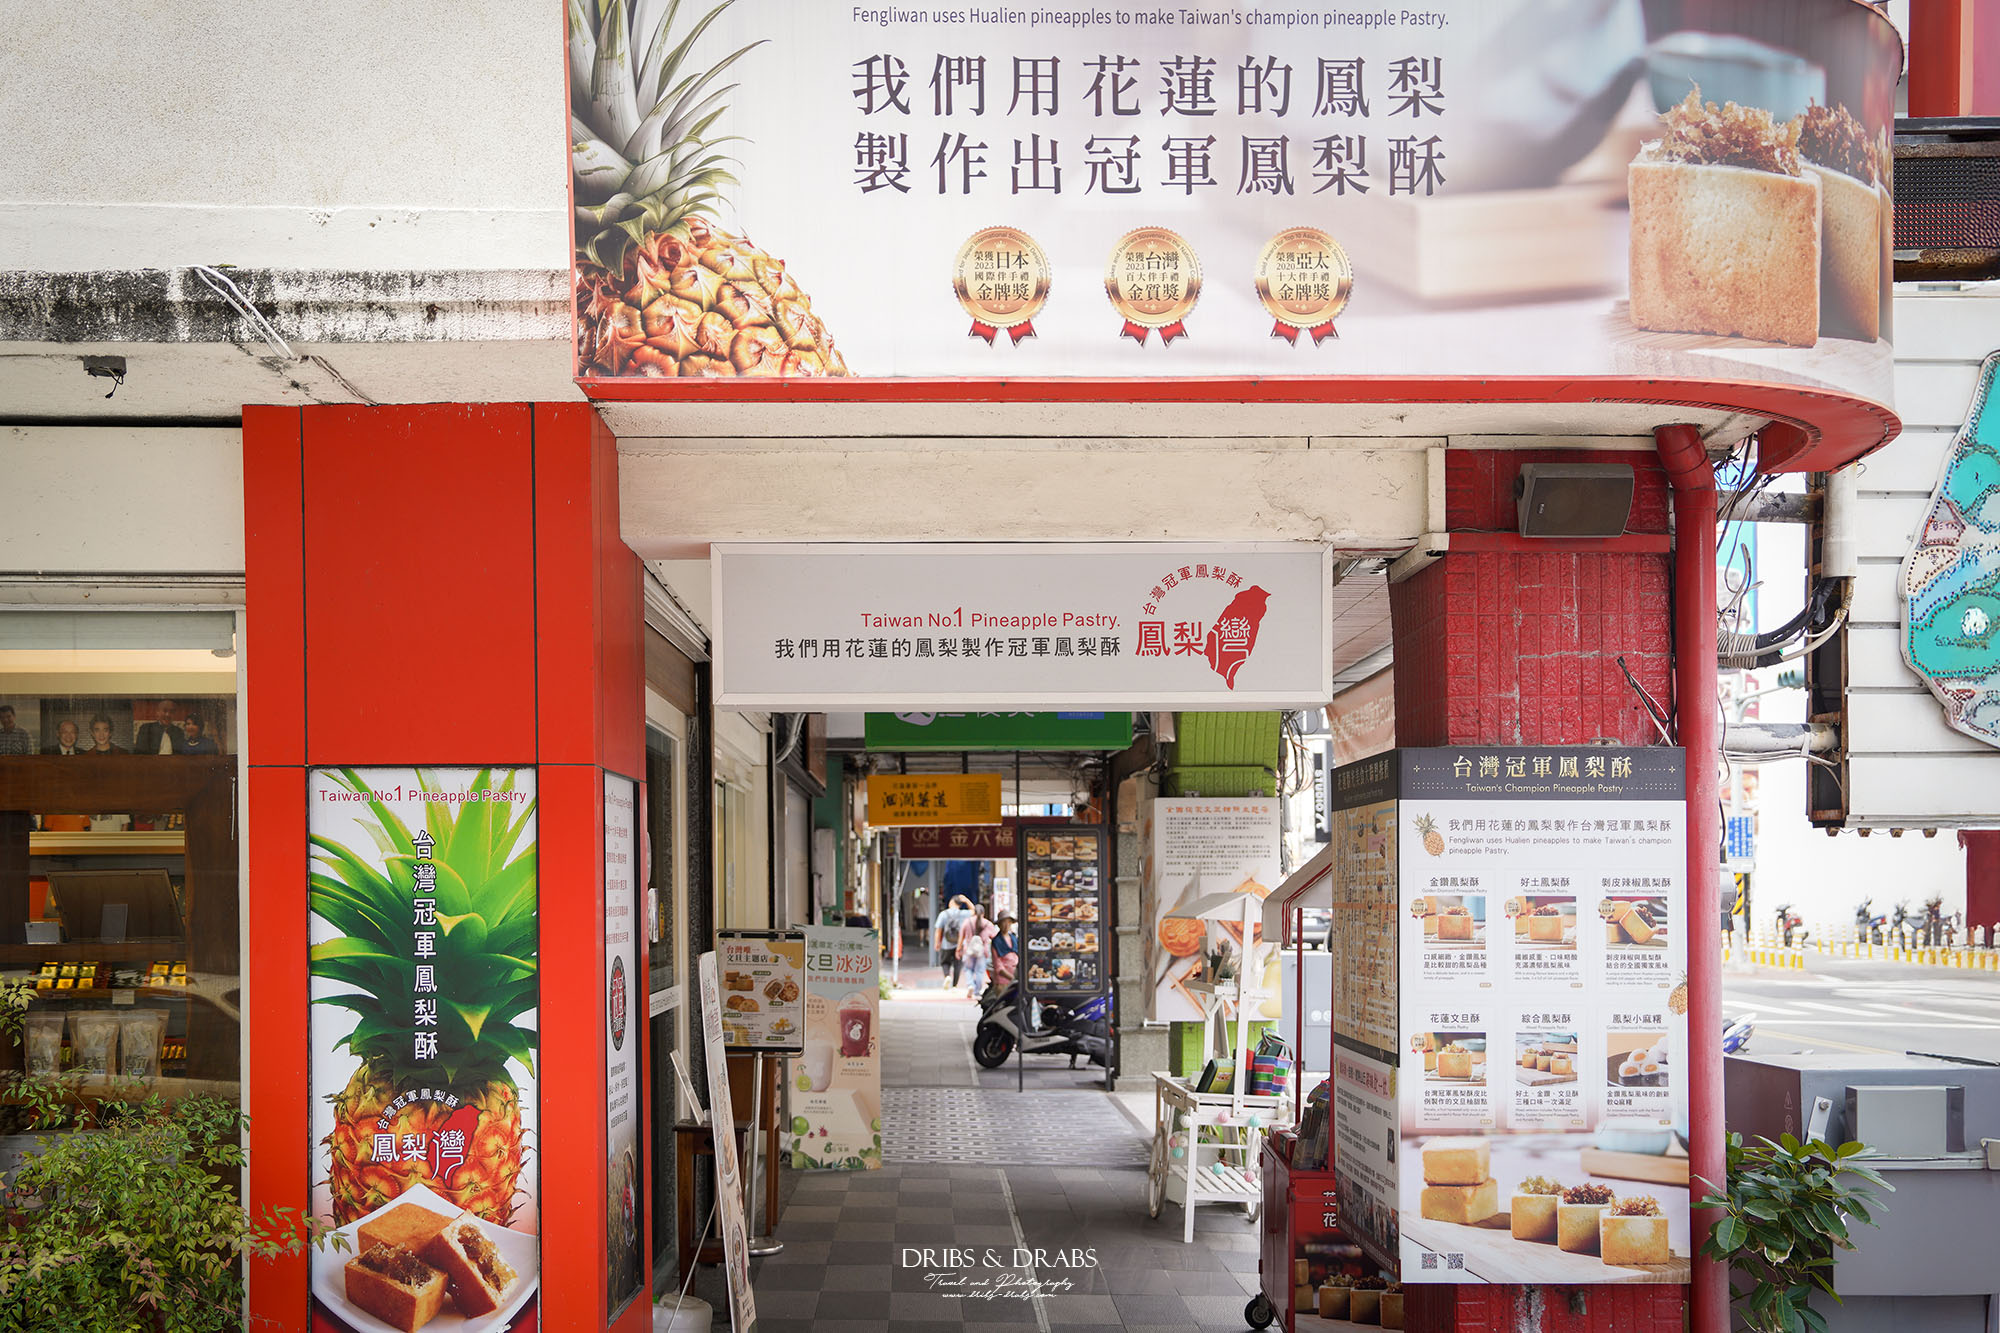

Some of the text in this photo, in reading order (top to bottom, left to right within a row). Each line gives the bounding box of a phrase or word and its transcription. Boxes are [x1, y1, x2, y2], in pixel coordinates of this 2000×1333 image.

[853, 7, 1449, 29] Fengliwan uses Hualien pineapples to make Taiwan's champion pineapple Pastry.
[852, 53, 1446, 117] 我們用花蓮的鳳梨
[853, 132, 1446, 196] 製作出冠軍鳳梨酥
[974, 262, 995, 270] 2023
[997, 250, 1029, 270] 日本
[1145, 251, 1179, 271] 台灣
[1296, 251, 1330, 270] 亞太
[977, 283, 1029, 301] 金牌獎
[1128, 283, 1179, 301] 金質獎
[1278, 283, 1330, 301] 金牌獎
[1142, 564, 1243, 615] 台灣冠軍鳳梨酥
[861, 607, 1121, 631] Taiwan No.1 Pineapple Pastry.
[775, 636, 1121, 659] 我們用花蓮的鳳梨製作冠軍鳳梨酥
[1135, 617, 1251, 680] 鳳梨灣
[1453, 755, 1632, 779] 台灣冠軍鳳梨酥
[319, 785, 527, 804] Taiwan No.1 Pineapple Pastry
[1465, 783, 1623, 795] Taiwan's Champion Pineapple Pastry
[1449, 819, 1672, 832] 我們用花蓮的鳳梨製作台灣冠軍鳳梨酥
[950, 827, 1014, 848] 金六福
[1449, 836, 1484, 846] Fengliwan
[1505, 836, 1530, 845] Hualien
[1533, 837, 1570, 846] pineapples
[1573, 837, 1580, 845] to
[1583, 836, 1602, 845] make
[1638, 836, 1672, 846] champion
[1449, 847, 1510, 855] pineapple Pastry.
[1430, 877, 1480, 887] 金鑽鳳梨酥
[1520, 877, 1570, 887] 好土鳳梨酥
[1601, 878, 1672, 888] 剝皮辣椒鳳梨酥
[411, 829, 439, 1061] 台灣冠軍鳳梨酥
[1430, 1013, 1480, 1023] 花蓮文旦酥
[1521, 1013, 1571, 1023] 綜合鳳梨酥
[377, 1088, 460, 1130] 台灣冠軍鳳梨酥
[371, 1129, 466, 1181] 鳳梨灣
